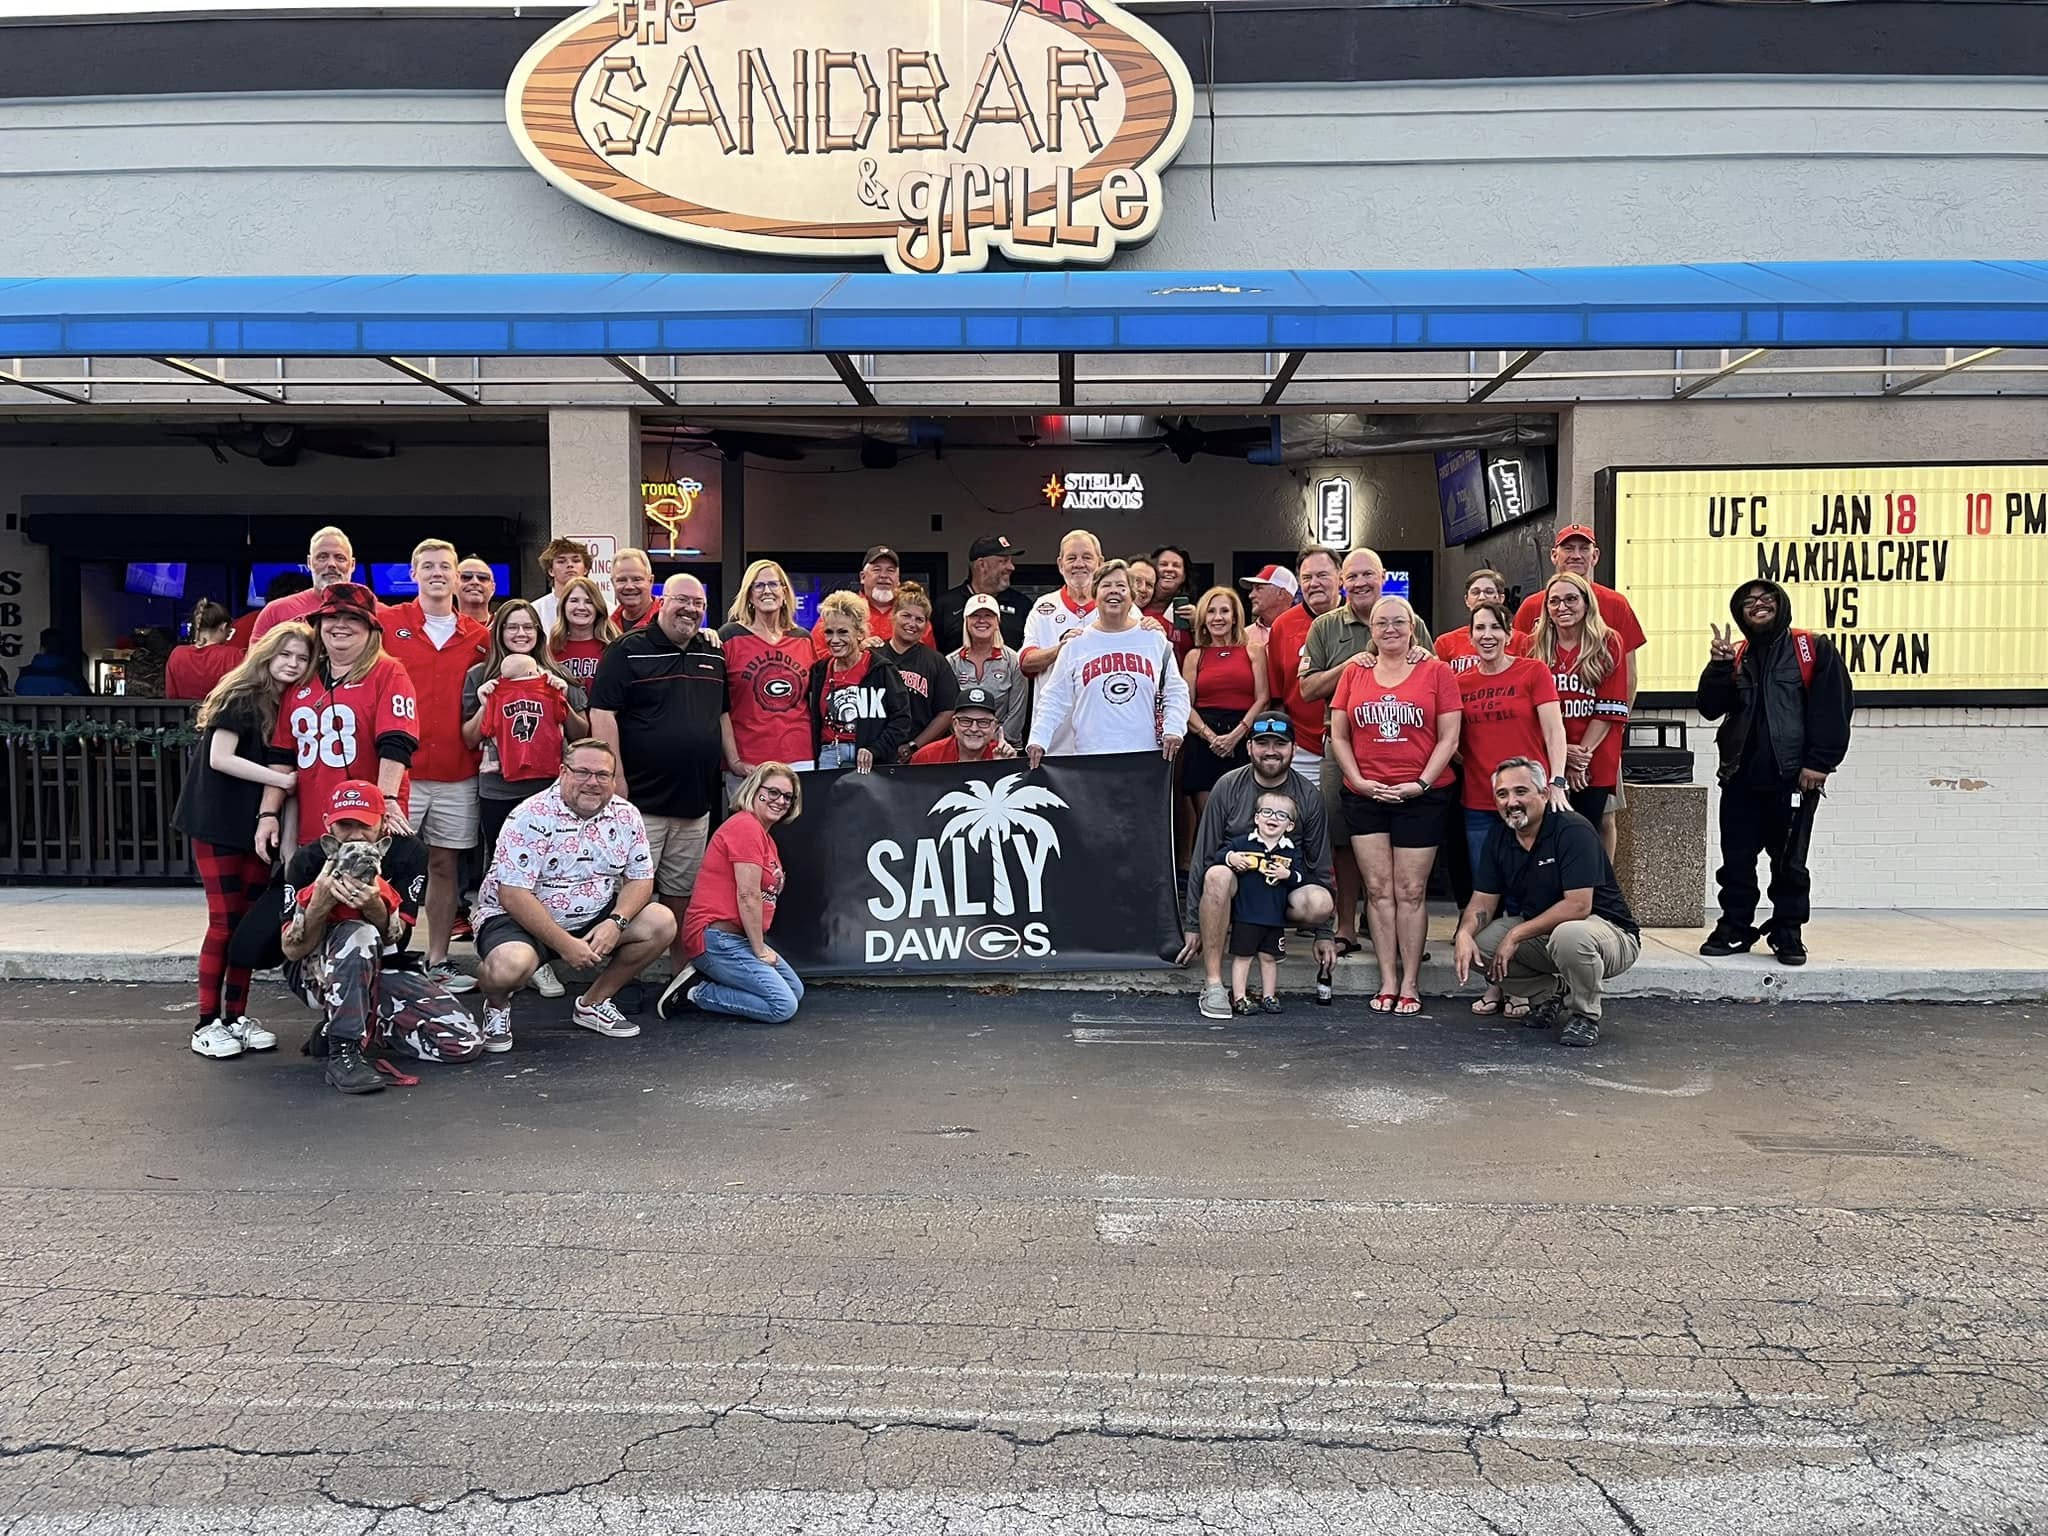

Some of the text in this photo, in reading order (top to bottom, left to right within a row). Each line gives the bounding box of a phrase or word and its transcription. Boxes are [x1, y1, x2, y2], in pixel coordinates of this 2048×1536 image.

[590, 45, 1109, 155] SANDBAR
[856, 157, 889, 210] &
[1064, 473, 1144, 491] STELLA
[1062, 490, 1143, 509] ARTOIS
[1709, 493, 2047, 537] UFC JAN 18 10 PM
[1824, 587, 1859, 628] VS
[742, 650, 807, 680] BULLDOGS
[1082, 653, 1155, 687] GEORGIA
[392, 694, 416, 719] 88
[1354, 705, 1424, 728] CHAMPIONS
[291, 704, 357, 768] 88
[334, 800, 370, 808] GEORGIA
